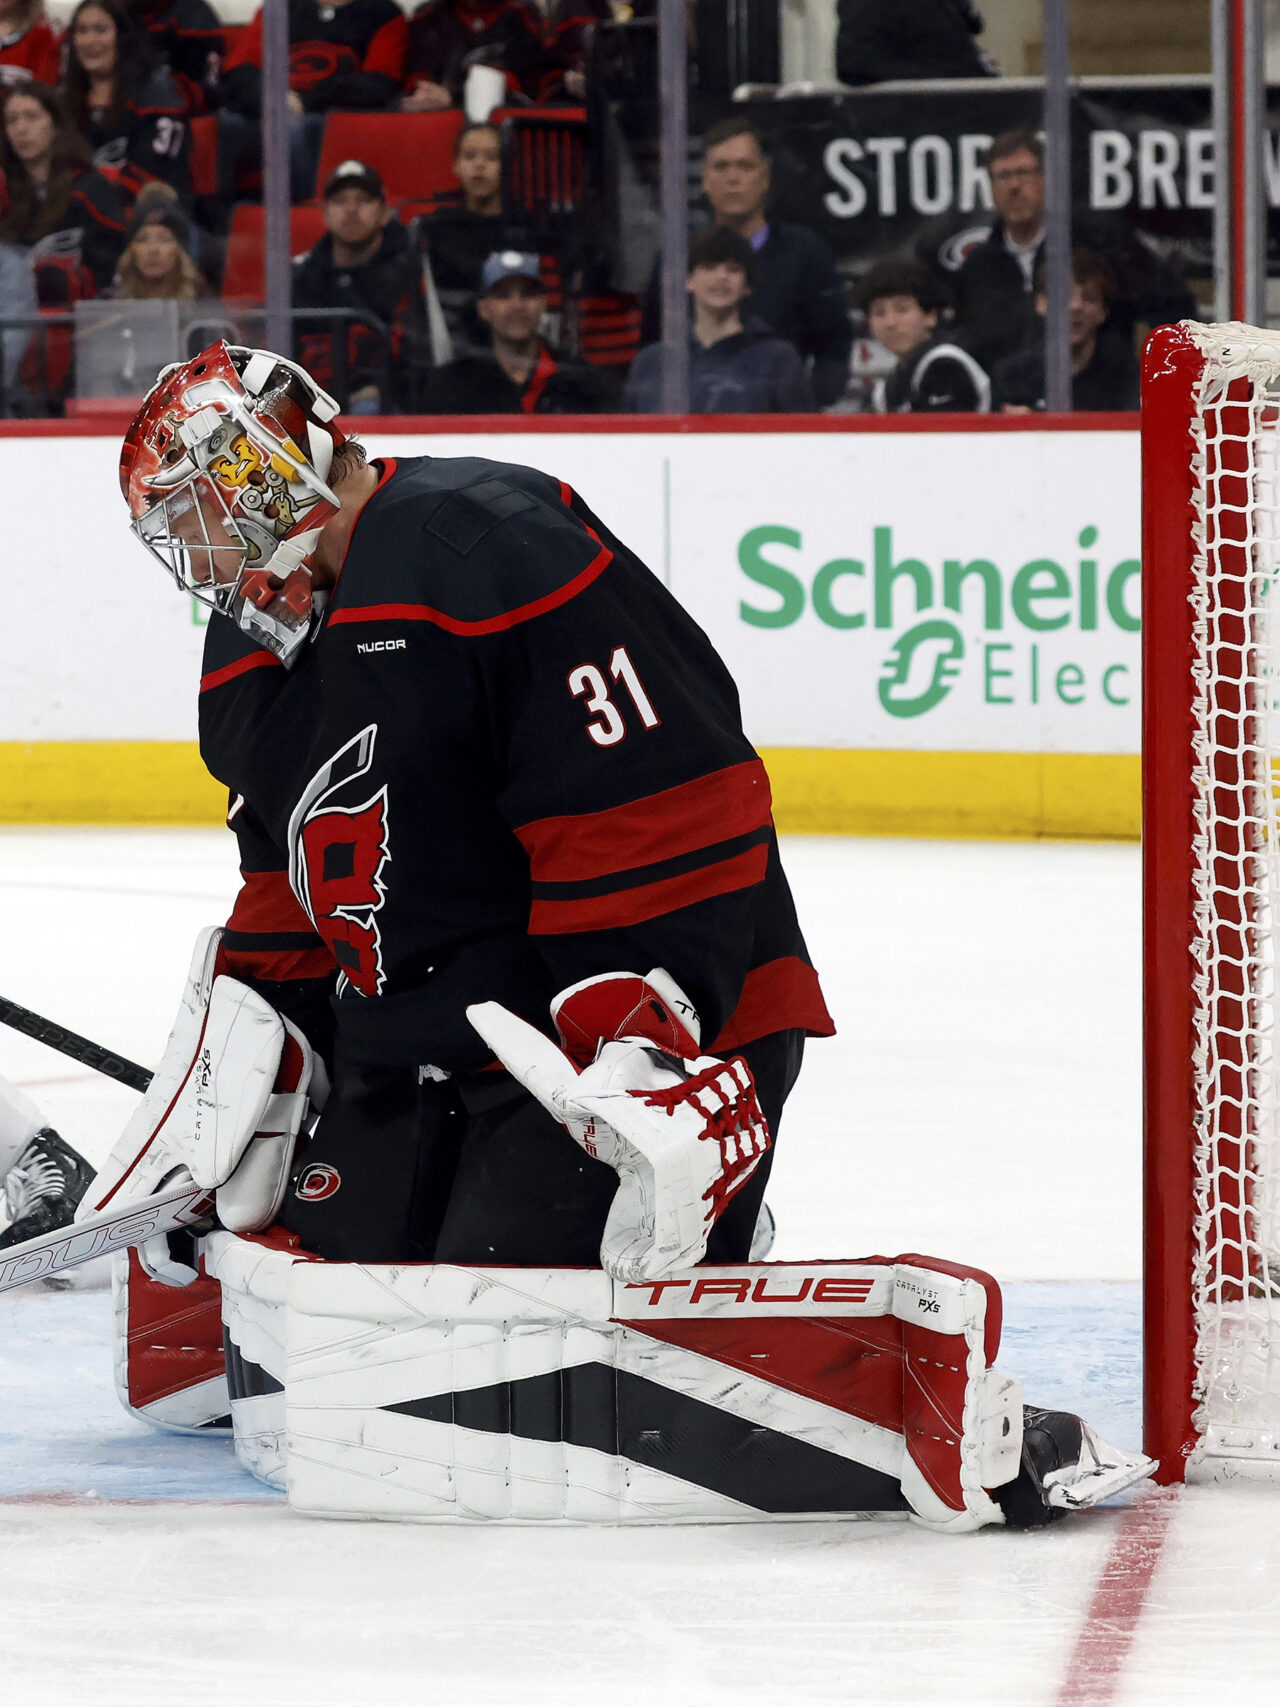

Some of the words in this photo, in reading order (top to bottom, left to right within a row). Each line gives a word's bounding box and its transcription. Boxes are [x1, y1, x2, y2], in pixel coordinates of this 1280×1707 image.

[356, 639, 407, 653] NUCOR
[983, 643, 1130, 705] Elec
[567, 645, 662, 748] 31
[579, 1115, 598, 1158] TRUE
[624, 1277, 876, 1306] TRUE
[896, 1279, 939, 1300] CATALYST
